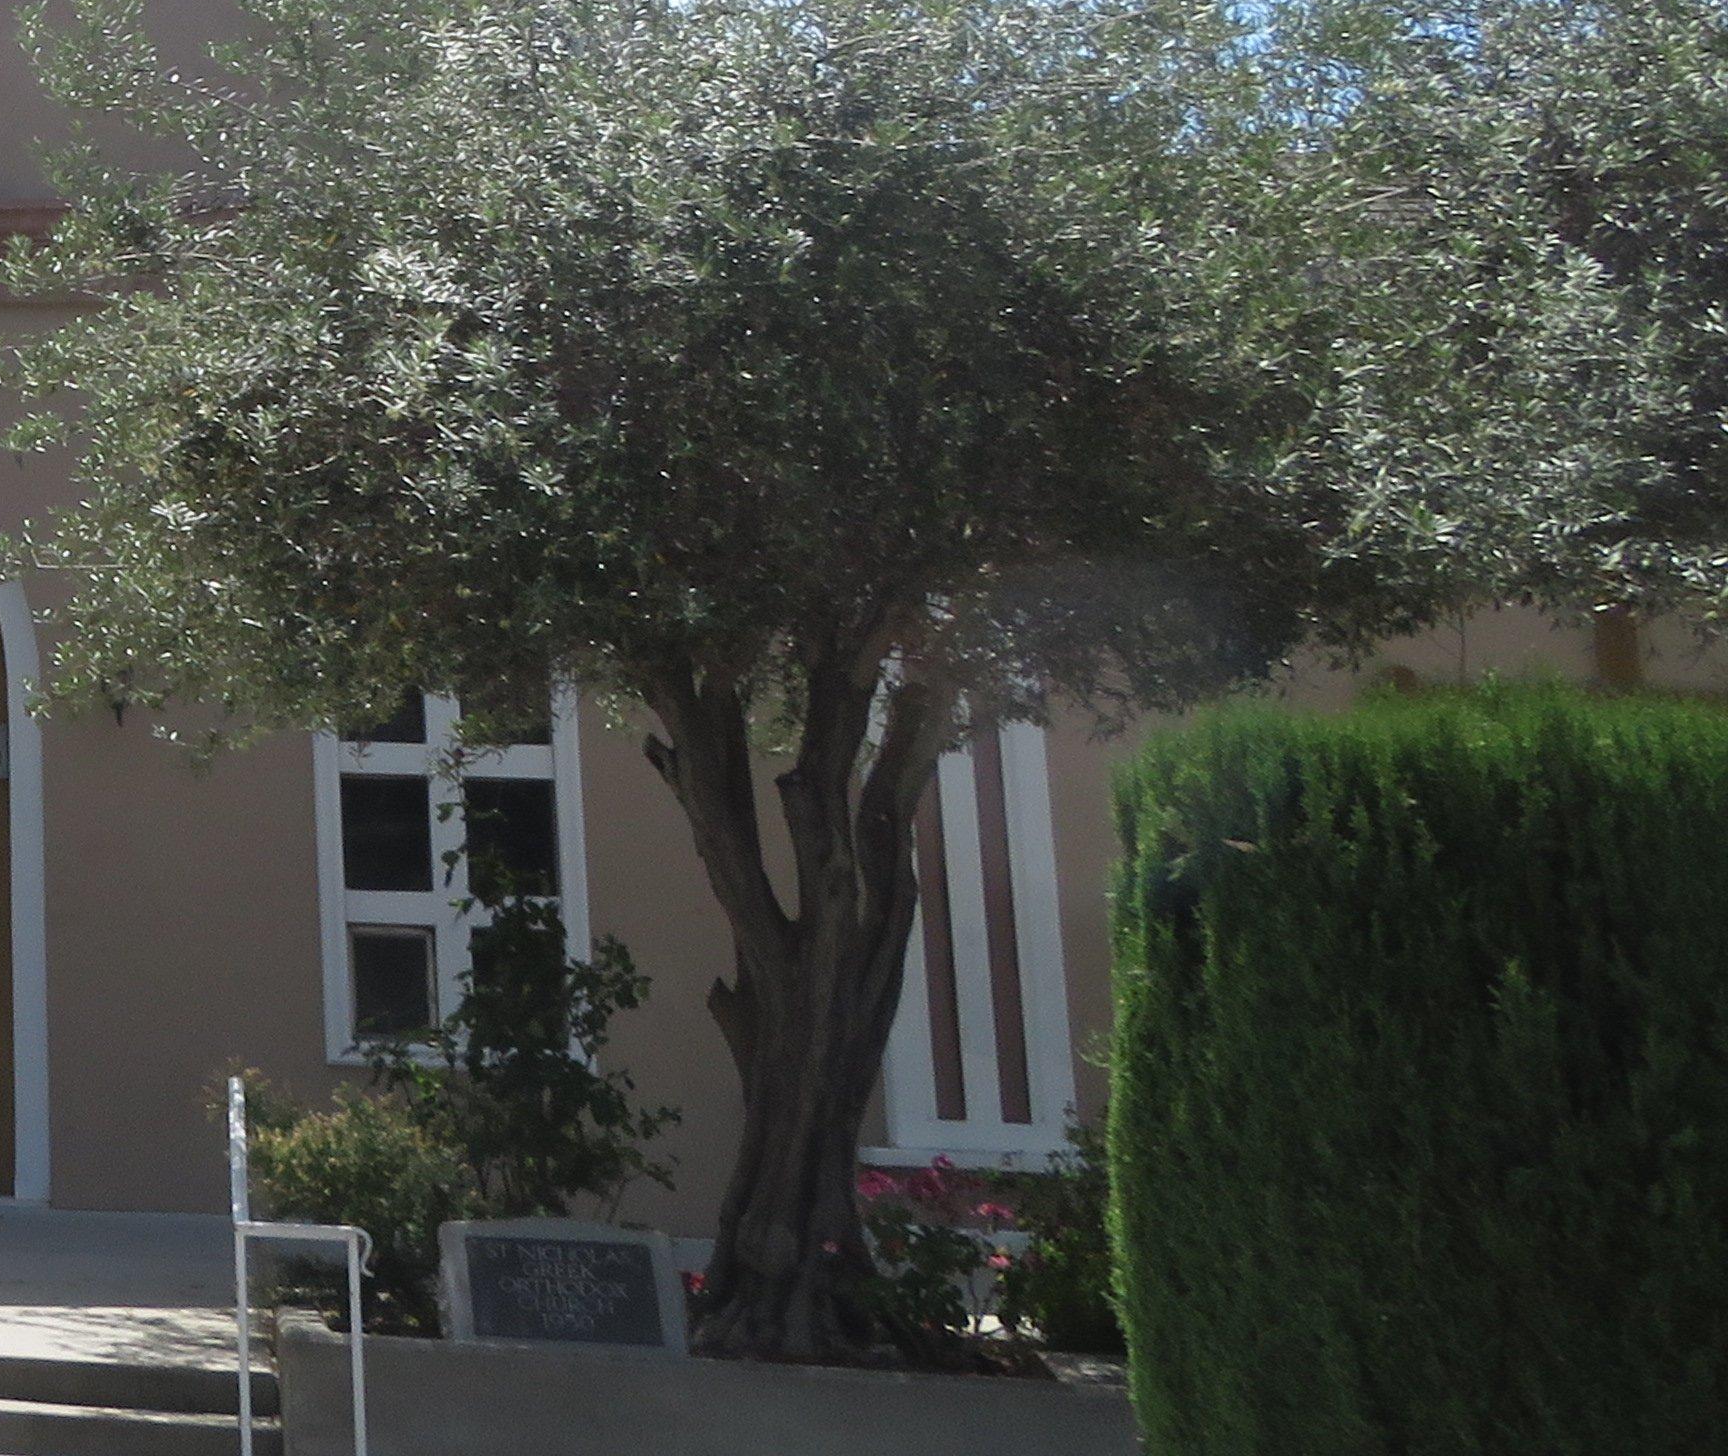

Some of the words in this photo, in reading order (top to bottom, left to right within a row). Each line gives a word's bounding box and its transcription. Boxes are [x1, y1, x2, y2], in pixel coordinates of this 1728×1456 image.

[485, 1242, 507, 1259] ST
[523, 1260, 598, 1281] GREEK
[497, 1276, 631, 1301] ORTHODOX
[517, 1295, 614, 1315] CHURCH
